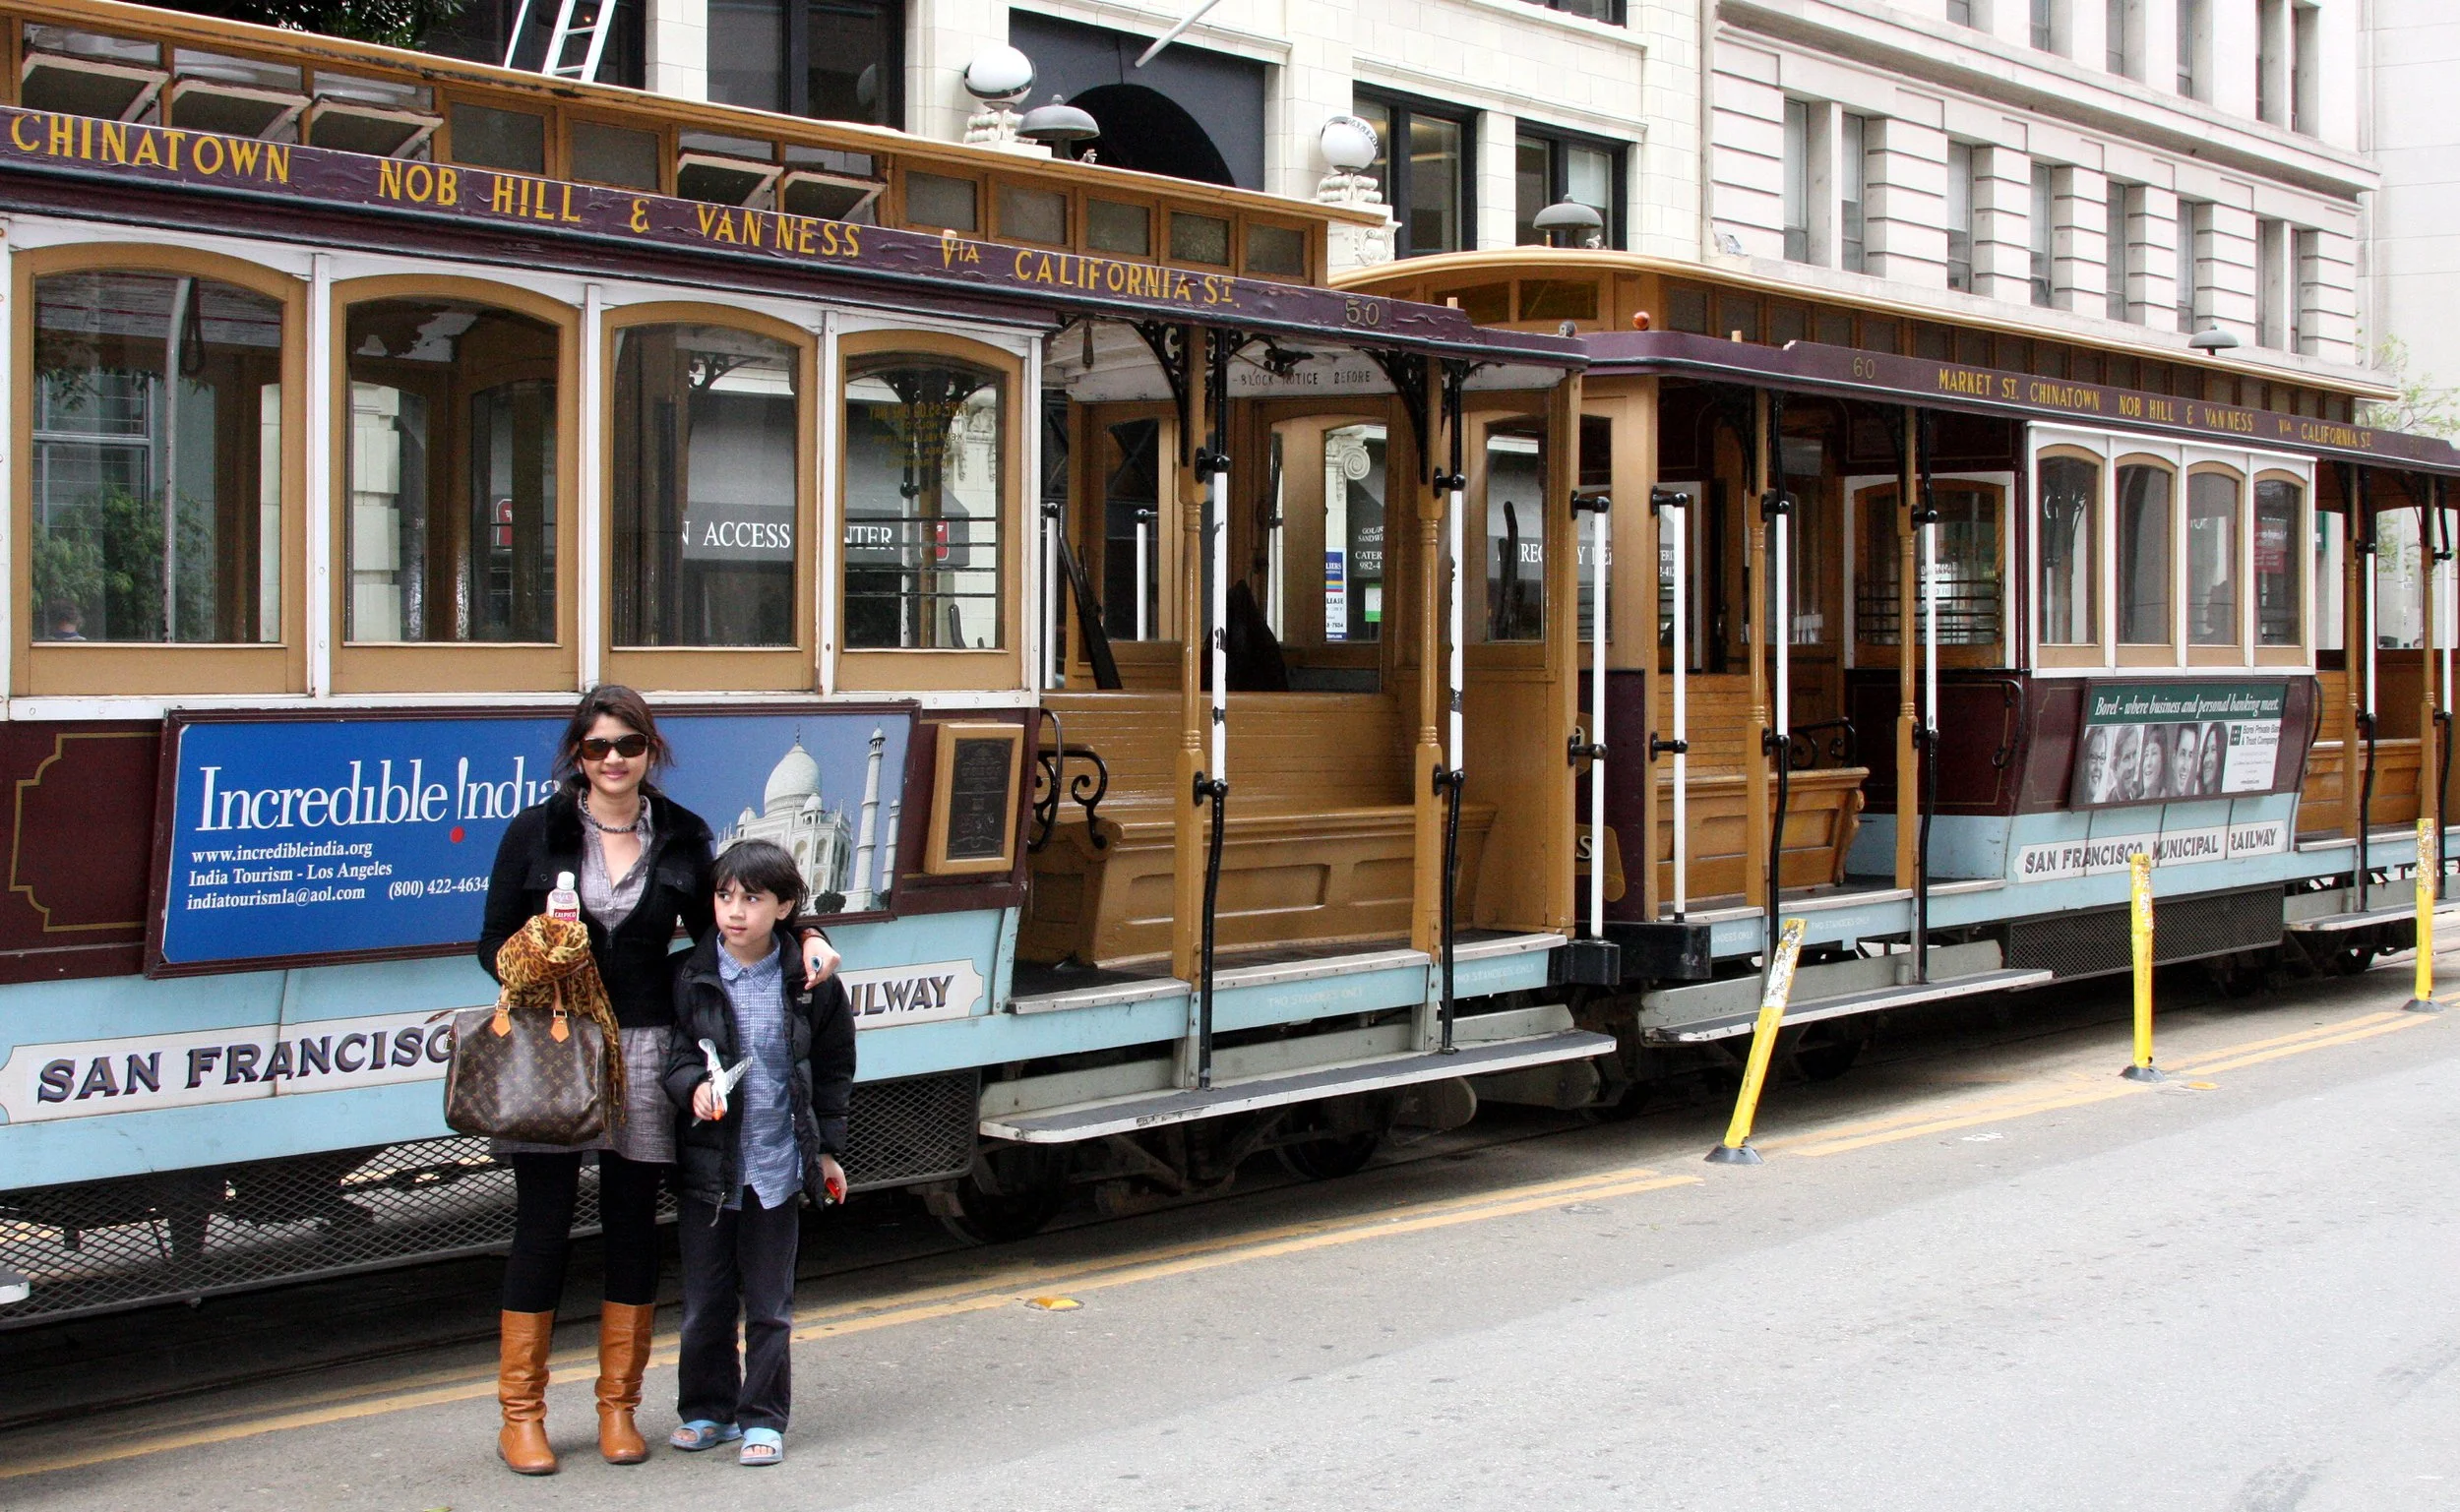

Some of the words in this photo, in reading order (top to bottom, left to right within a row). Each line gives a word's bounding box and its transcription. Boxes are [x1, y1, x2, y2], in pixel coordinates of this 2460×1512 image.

[11, 113, 289, 184] CHINATOWN
[379, 159, 458, 206] NOB
[492, 175, 582, 222] HILL
[697, 204, 764, 247] VAN
[775, 213, 861, 258] NESS
[1015, 251, 1193, 303] CALIFORNIA
[1345, 299, 1380, 326] 50
[1853, 356, 1876, 380] 60
[1938, 368, 1993, 396] MARKET
[2030, 382, 2100, 411] CHINATOWN
[2119, 394, 2141, 417] NOB
[2149, 399, 2174, 422] HILL
[2204, 407, 2225, 430] VAN
[2228, 410, 2253, 433] NESS
[2301, 422, 2358, 448] CALIFORNIA
[703, 520, 791, 548] ACCESS
[845, 525, 894, 550] NTER
[1361, 525, 1384, 535] GOUR
[1355, 550, 1383, 560] CATER
[1359, 562, 1381, 571] 982-4
[2094, 695, 2119, 716] Borel
[2123, 695, 2149, 715] where
[2150, 695, 2181, 714] business
[2181, 694, 2200, 713] and
[2195, 693, 2231, 719] personal
[2230, 693, 2261, 717] banking
[195, 758, 449, 831] Incredible
[191, 840, 373, 864] www.incredibleindia.org
[2024, 849, 2058, 875] SAN
[2151, 834, 2219, 860] MUNICIPAL
[2230, 827, 2278, 851] RAILWAY
[188, 869, 228, 886] India
[232, 865, 293, 884] Tourism
[306, 864, 334, 880] Los
[337, 861, 393, 881] Angeles
[187, 885, 365, 910] indiatourismla@aol.com
[389, 879, 424, 901] (800)
[427, 876, 490, 896] 422-4634
[37, 1051, 161, 1105] SAN
[184, 1023, 456, 1090] FRANCISC
[851, 974, 954, 1018] ILWAY
